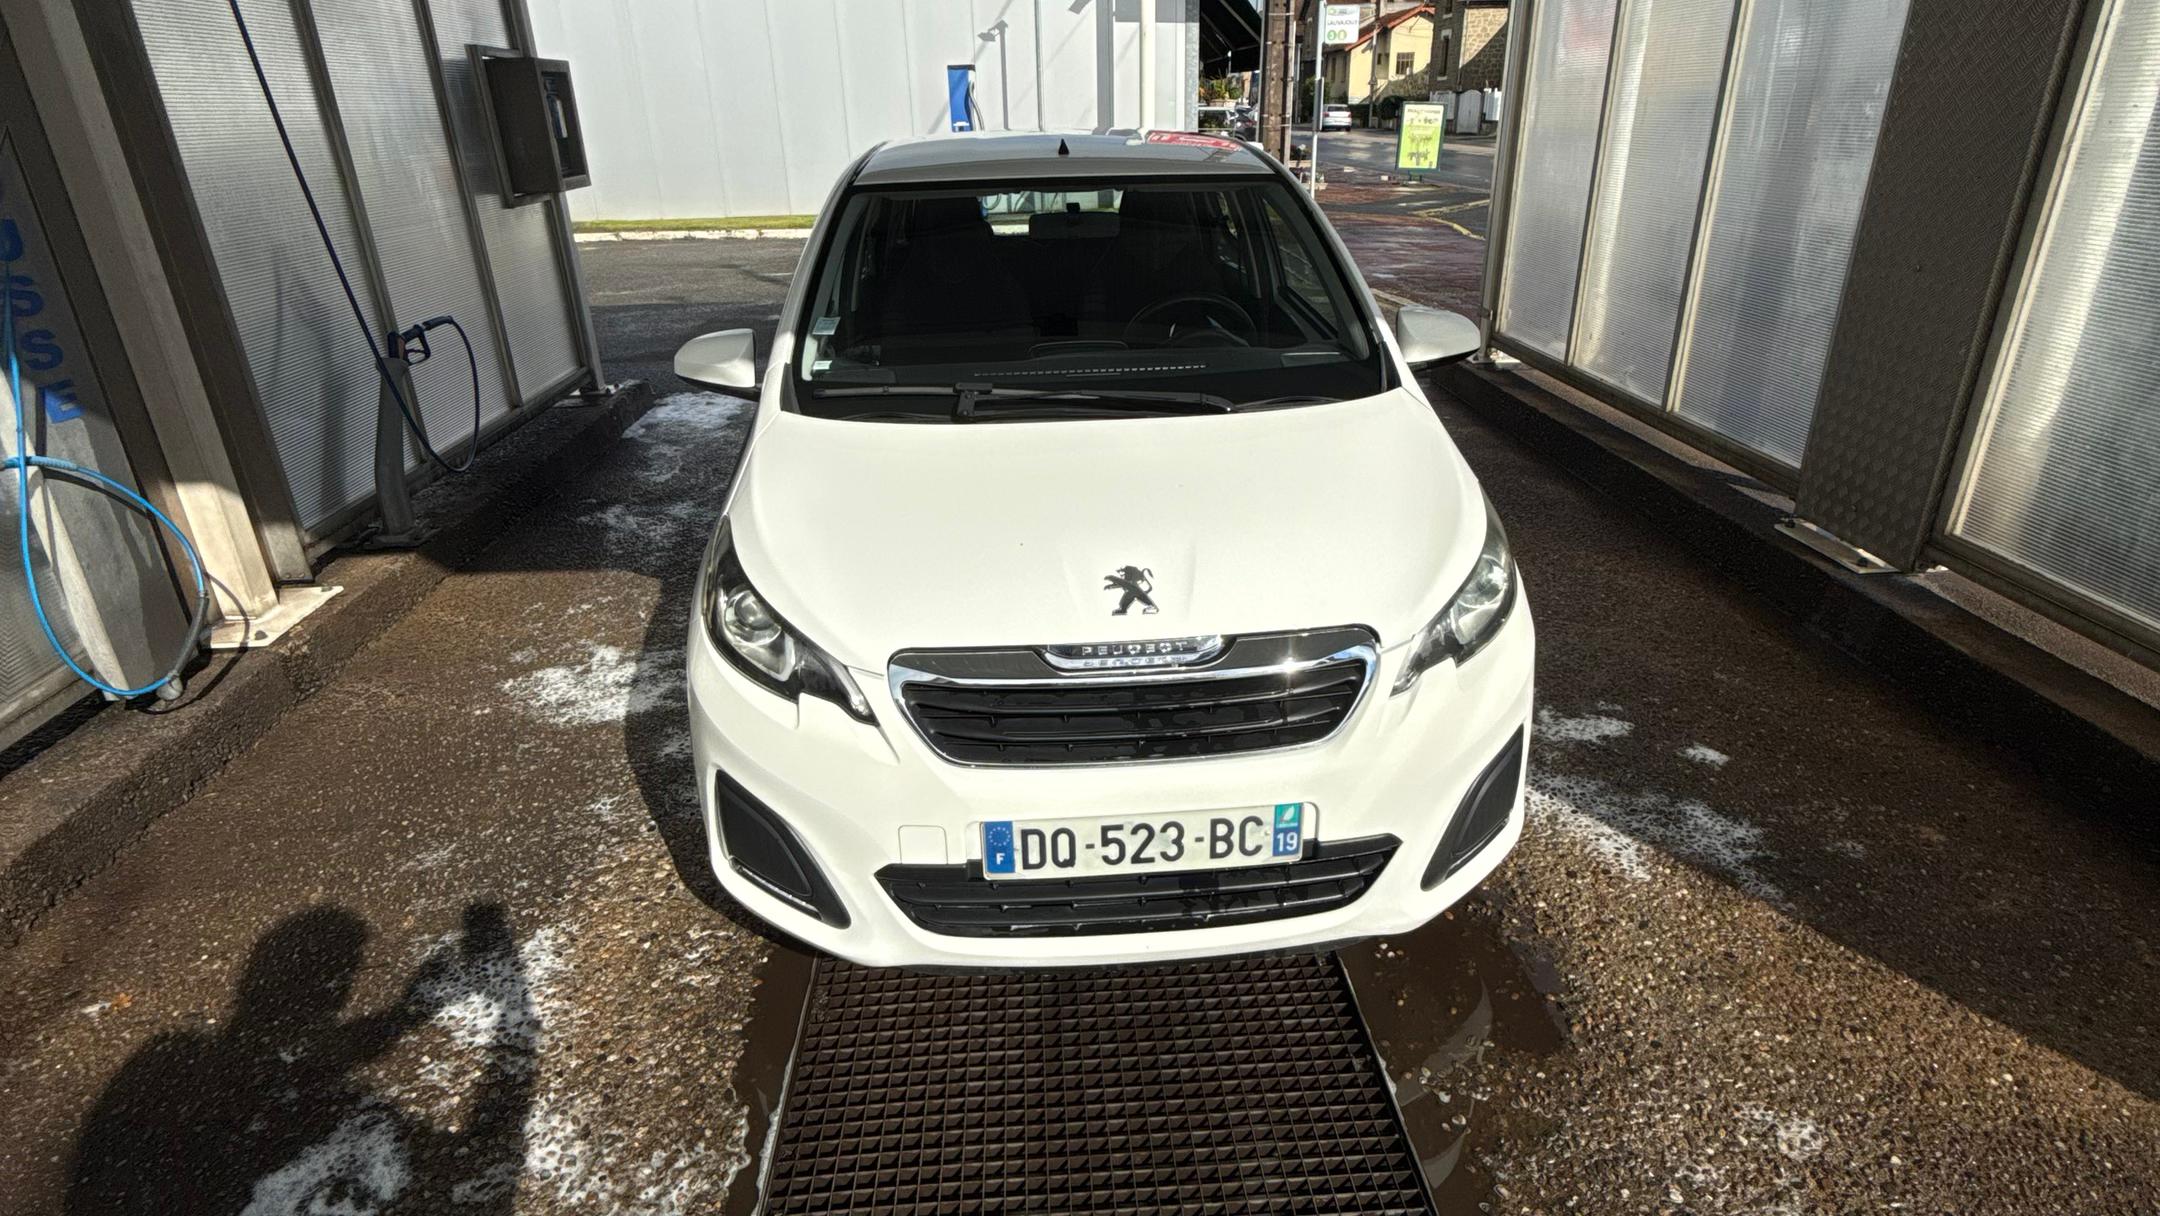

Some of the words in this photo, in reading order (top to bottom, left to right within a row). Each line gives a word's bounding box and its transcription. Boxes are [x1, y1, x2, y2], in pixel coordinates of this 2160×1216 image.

[1082, 641, 1188, 656] PEUGEOT
[996, 853, 1005, 865] F
[1021, 816, 1263, 870] DQ-523-BC
[1276, 832, 1298, 852] 19
